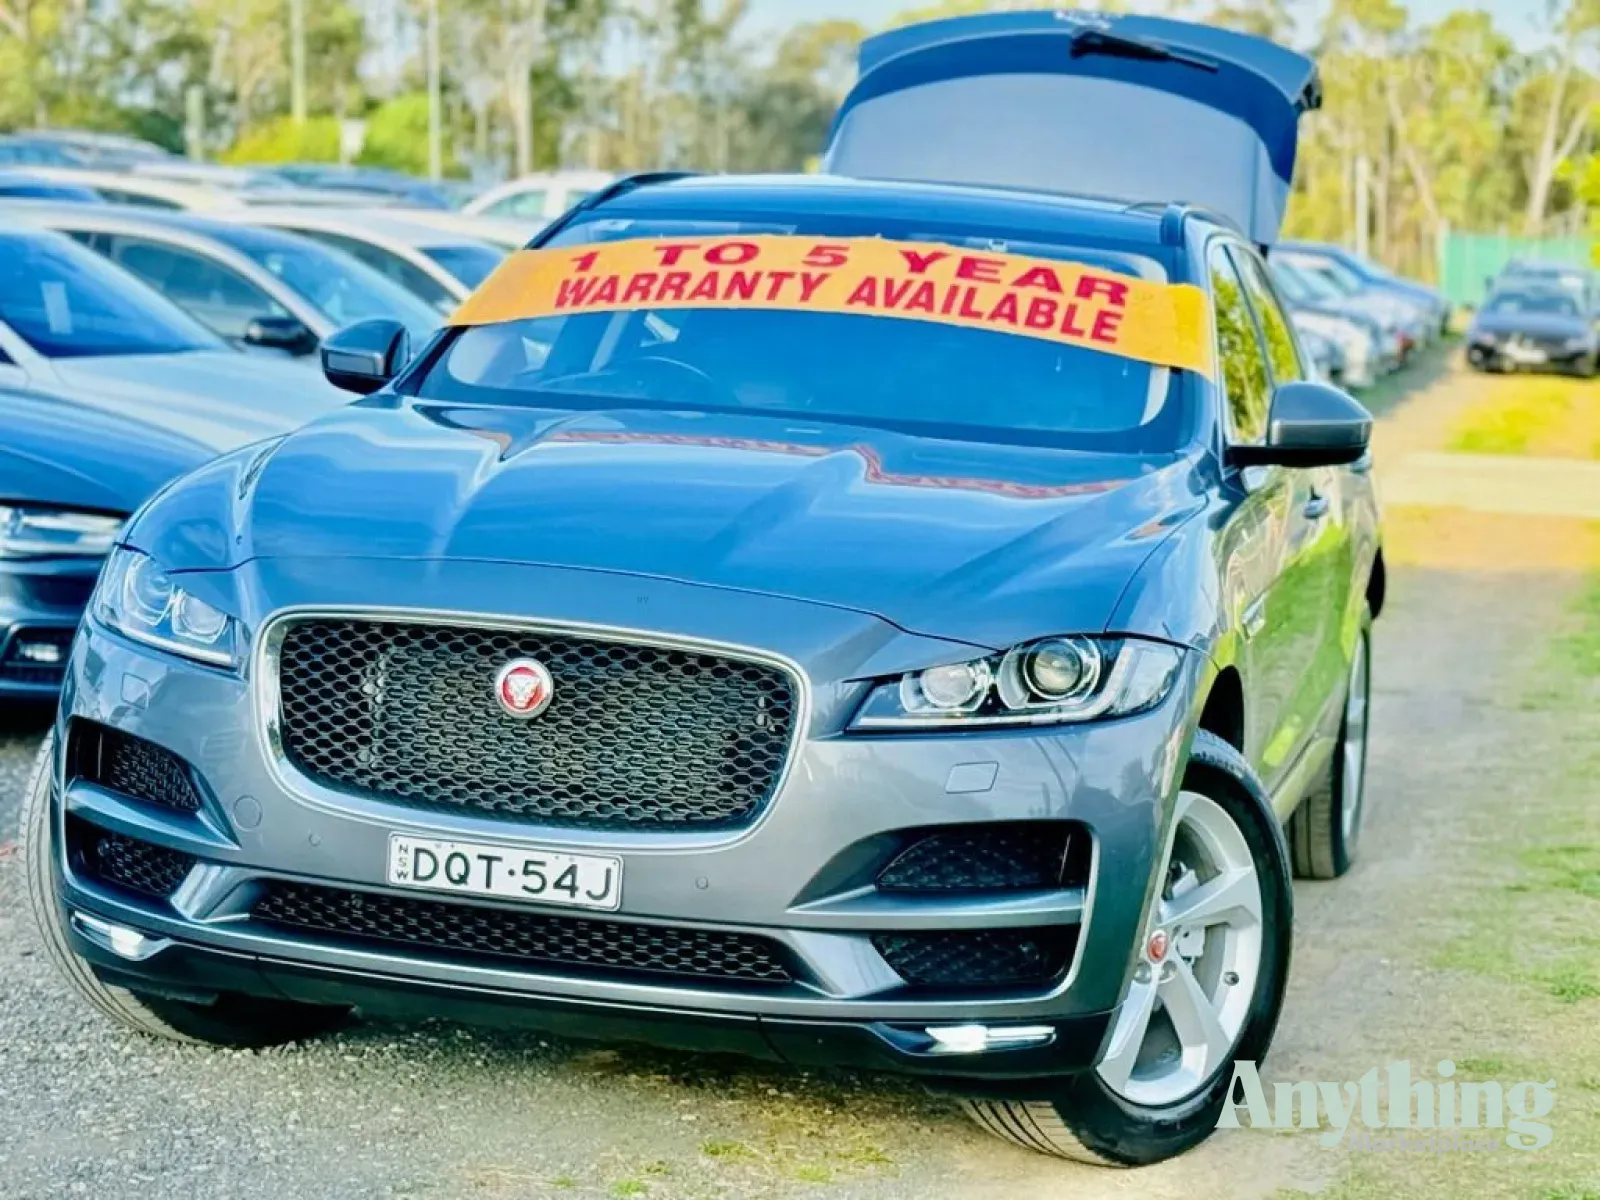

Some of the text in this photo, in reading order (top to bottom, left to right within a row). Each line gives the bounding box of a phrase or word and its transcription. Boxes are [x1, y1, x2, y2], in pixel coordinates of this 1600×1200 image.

[554, 271, 1124, 344] WARRANTY AVAILABLE
[569, 242, 1129, 308] 1 TO 5 YEAR
